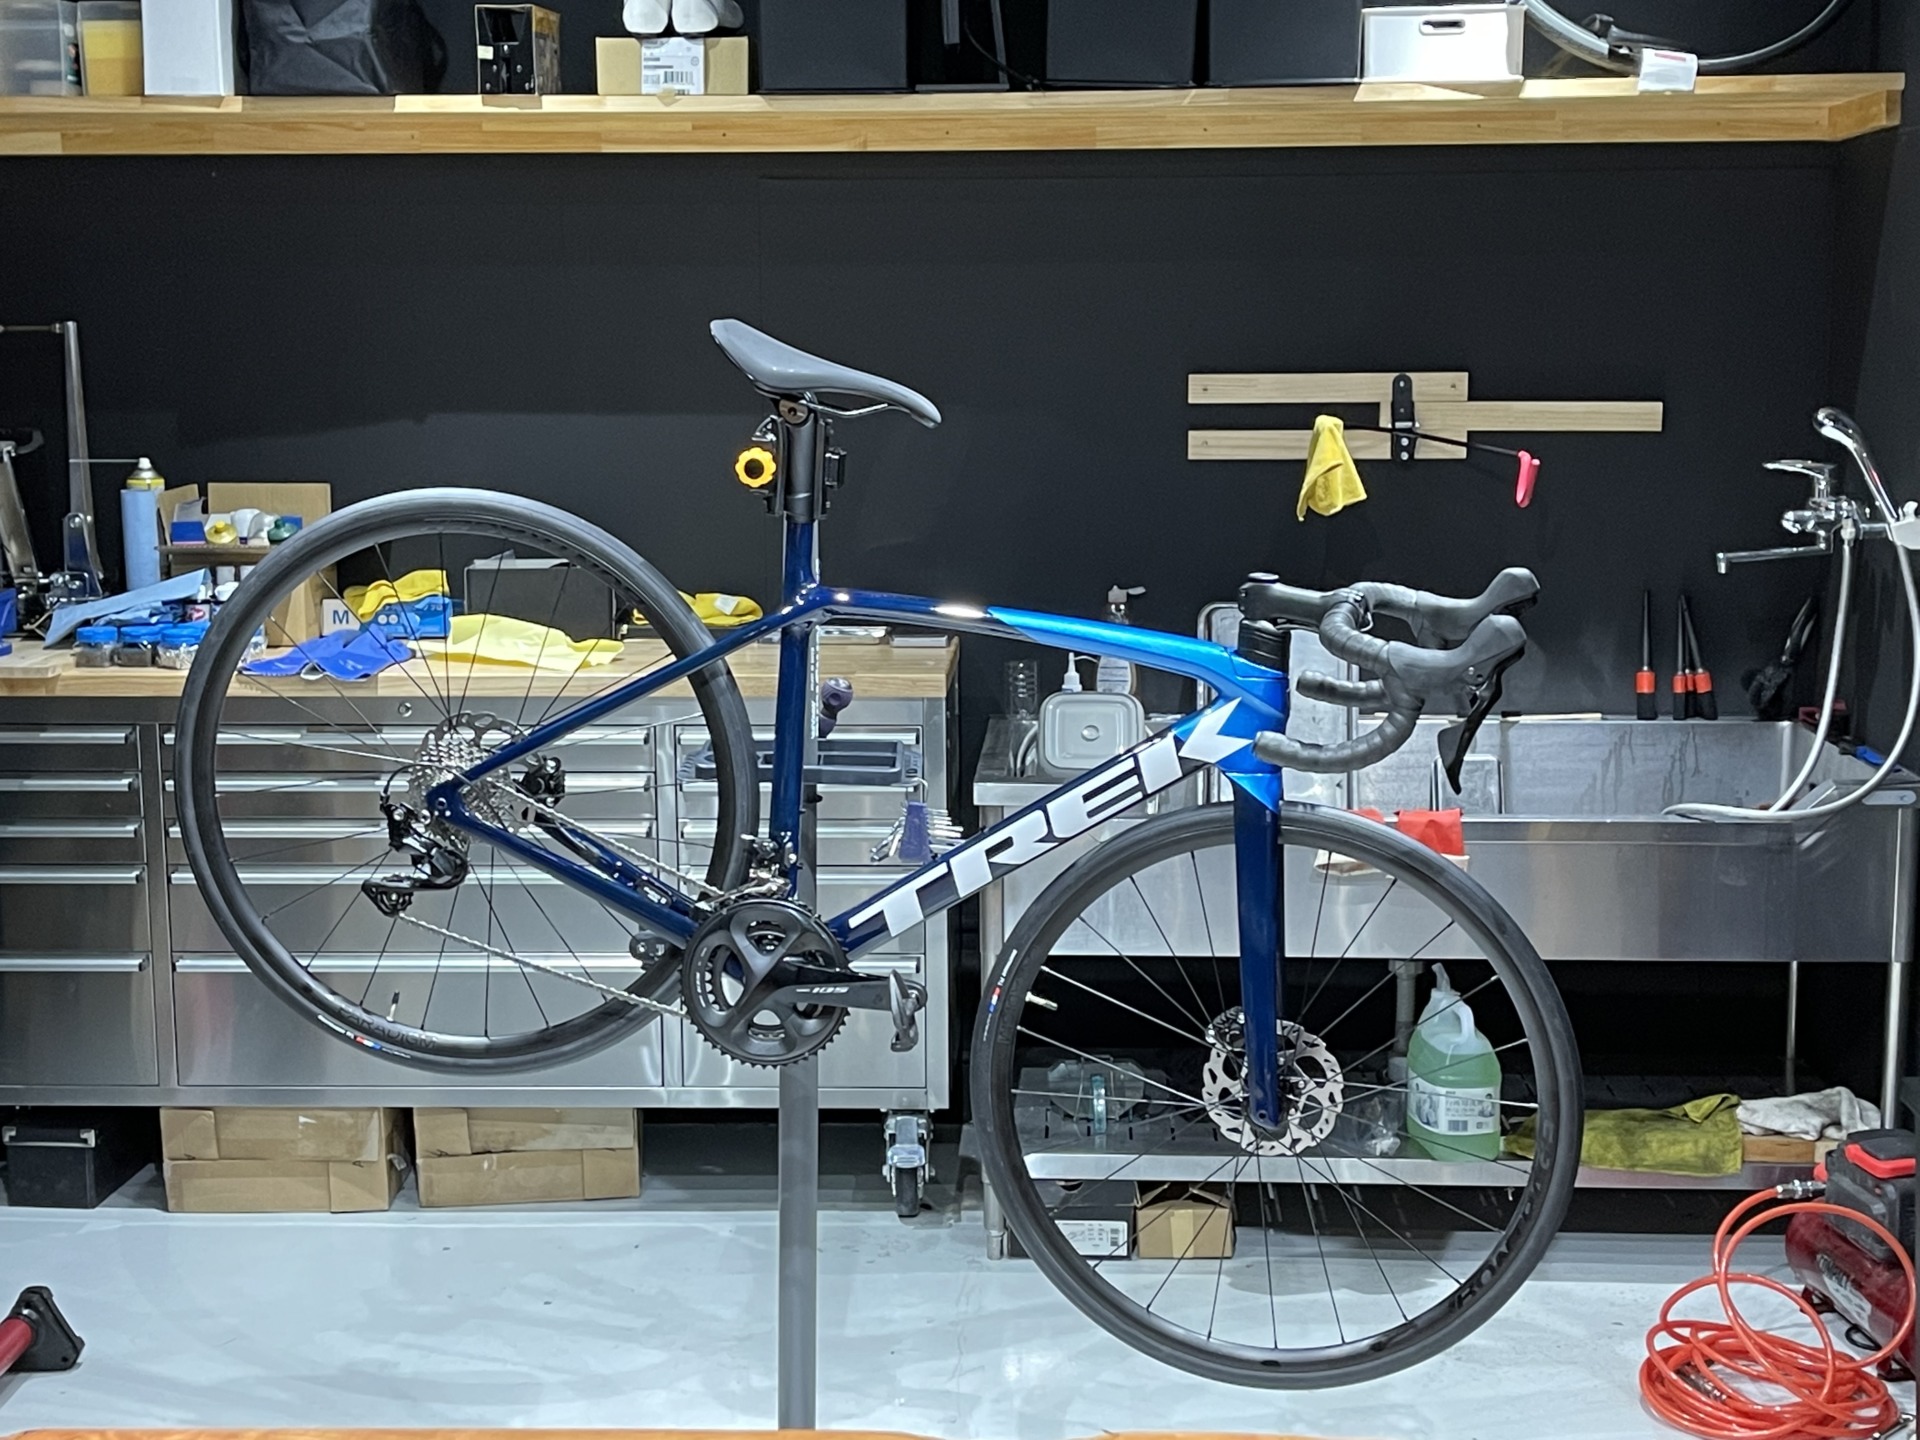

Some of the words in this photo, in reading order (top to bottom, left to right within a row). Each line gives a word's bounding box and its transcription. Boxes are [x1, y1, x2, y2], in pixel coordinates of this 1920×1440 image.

[332, 609, 350, 625] M
[847, 696, 1252, 937] TREK
[812, 986, 850, 994] 105
[338, 1004, 438, 1050] PARADIGM
[1455, 1104, 1556, 1310] BONTRAGE
